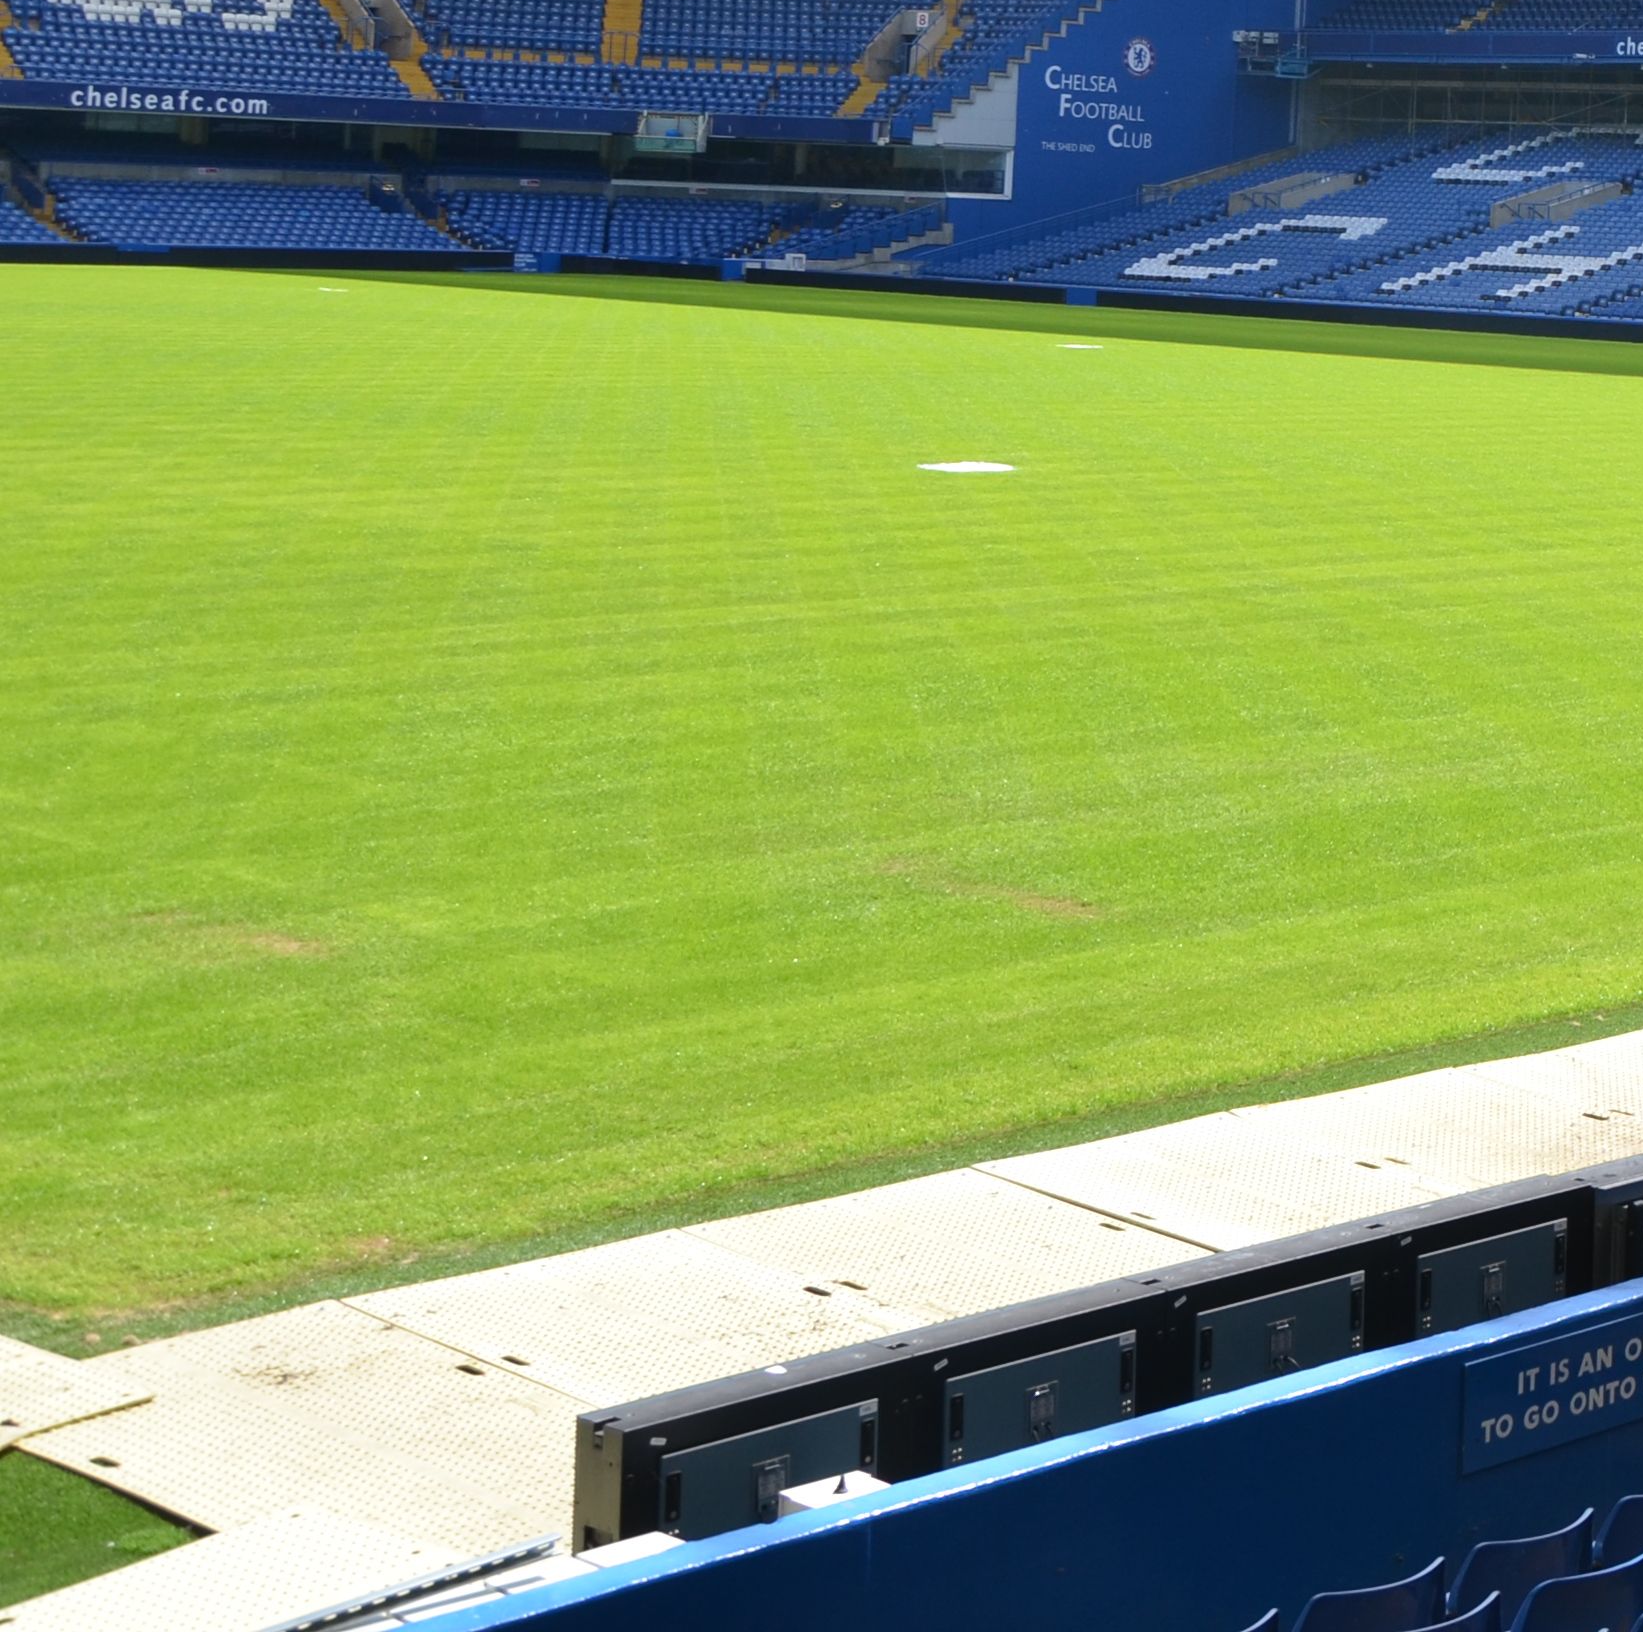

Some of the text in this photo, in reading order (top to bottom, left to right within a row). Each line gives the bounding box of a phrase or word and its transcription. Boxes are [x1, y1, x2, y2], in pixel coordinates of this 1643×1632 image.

[919, 14, 926, 26] 8
[1044, 65, 1117, 93] CHELSEA
[70, 85, 268, 115] chelseafc.com
[1059, 93, 1145, 122] FOOTBALL
[1107, 124, 1152, 149] CLUB
[1517, 1367, 1540, 1395] IT
[1550, 1358, 1569, 1386] IS
[1578, 1345, 1613, 1378] AN
[1481, 1414, 1514, 1444] TO
[1523, 1400, 1560, 1430] GO
[1569, 1376, 1636, 1416] ONTO
